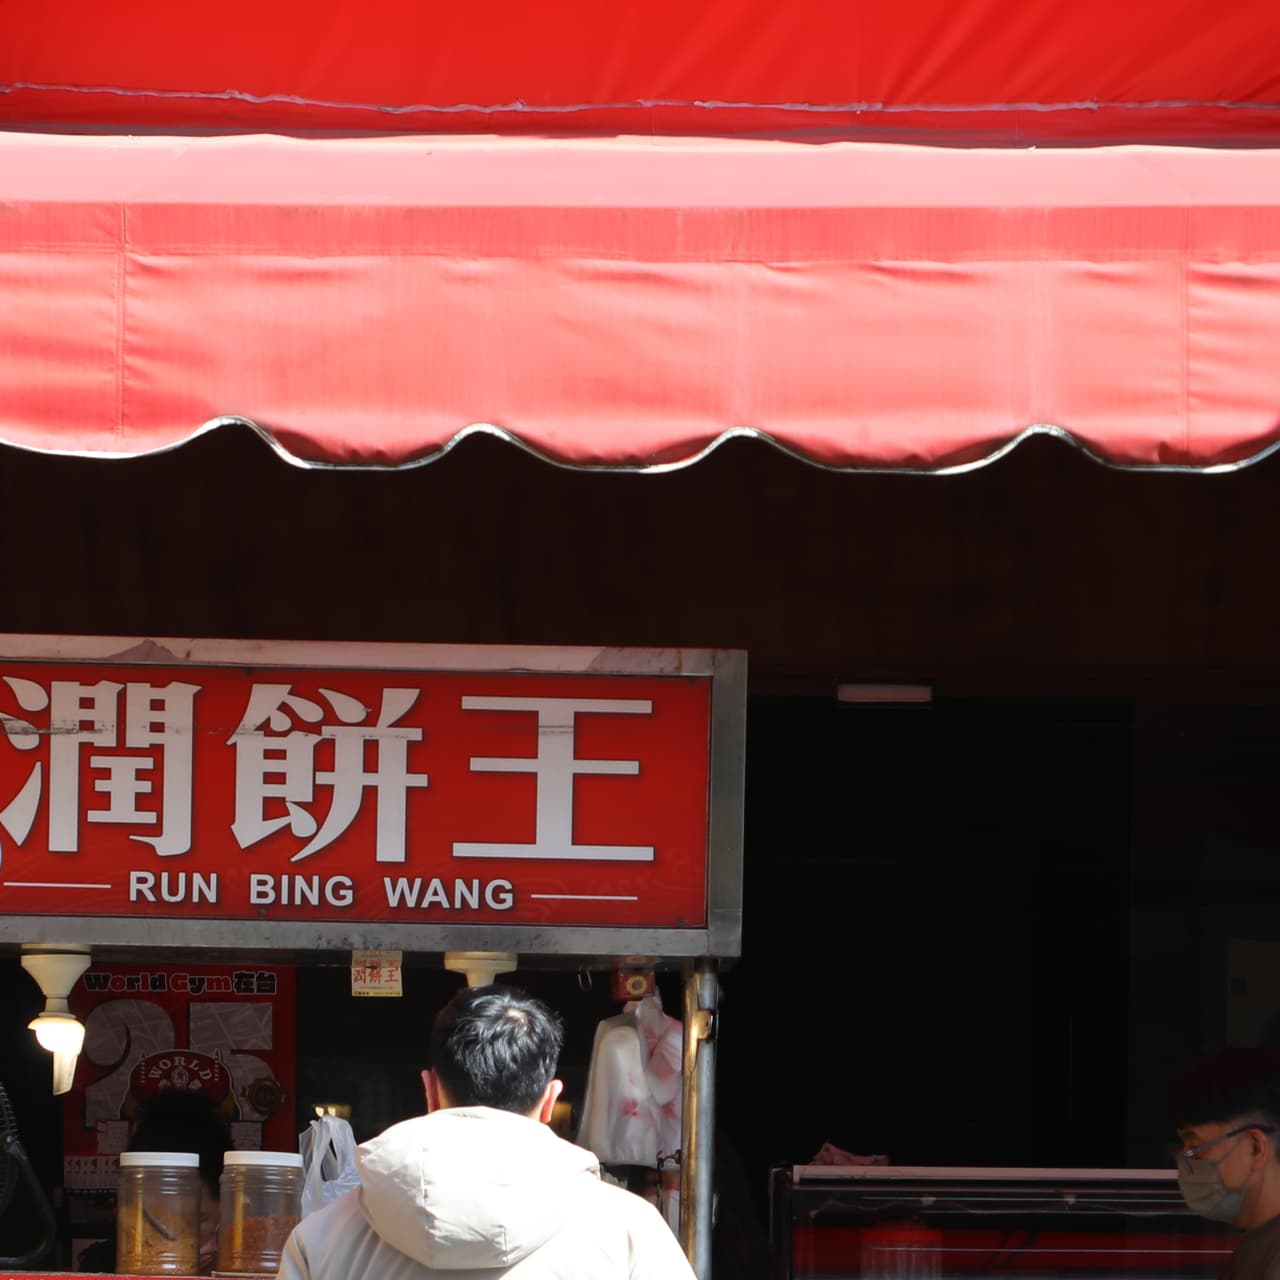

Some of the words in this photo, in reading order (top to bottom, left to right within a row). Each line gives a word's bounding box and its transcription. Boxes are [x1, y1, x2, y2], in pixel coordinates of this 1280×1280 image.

[128, 871, 219, 905] RUN
[249, 873, 355, 909] BING
[384, 876, 516, 912] WANG
[84, 971, 169, 993] World
[169, 972, 233, 996] Gym
[233, 970, 278, 996] 在台
[147, 1056, 214, 1082] WORLD
